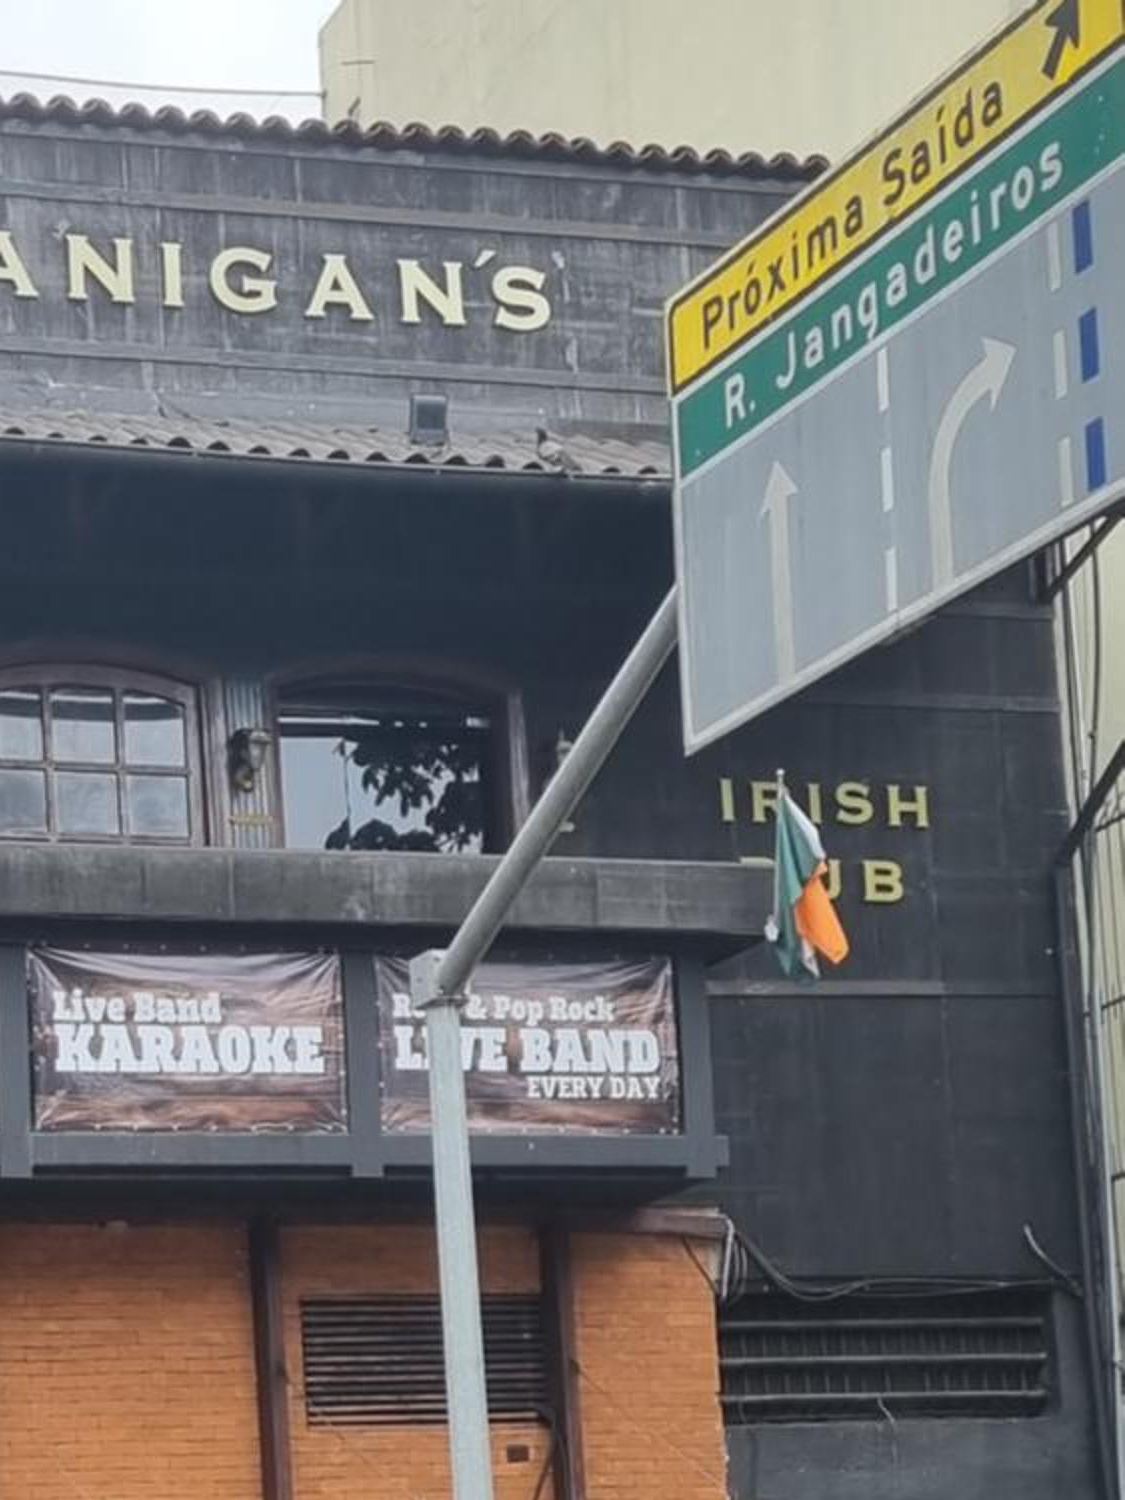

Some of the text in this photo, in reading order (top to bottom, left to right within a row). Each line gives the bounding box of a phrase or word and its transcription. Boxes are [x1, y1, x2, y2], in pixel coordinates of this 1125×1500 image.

[701, 81, 1003, 349] Próxima Saída
[724, 142, 1063, 428] R. Jangadeiros
[53, 989, 222, 1023] Live Band
[492, 994, 544, 1025] Pop
[550, 996, 615, 1022] Rock
[55, 1023, 325, 1074] KARAOKE
[394, 1025, 660, 1073] LVE BAND
[528, 1076, 661, 1099] EVERY DAY
